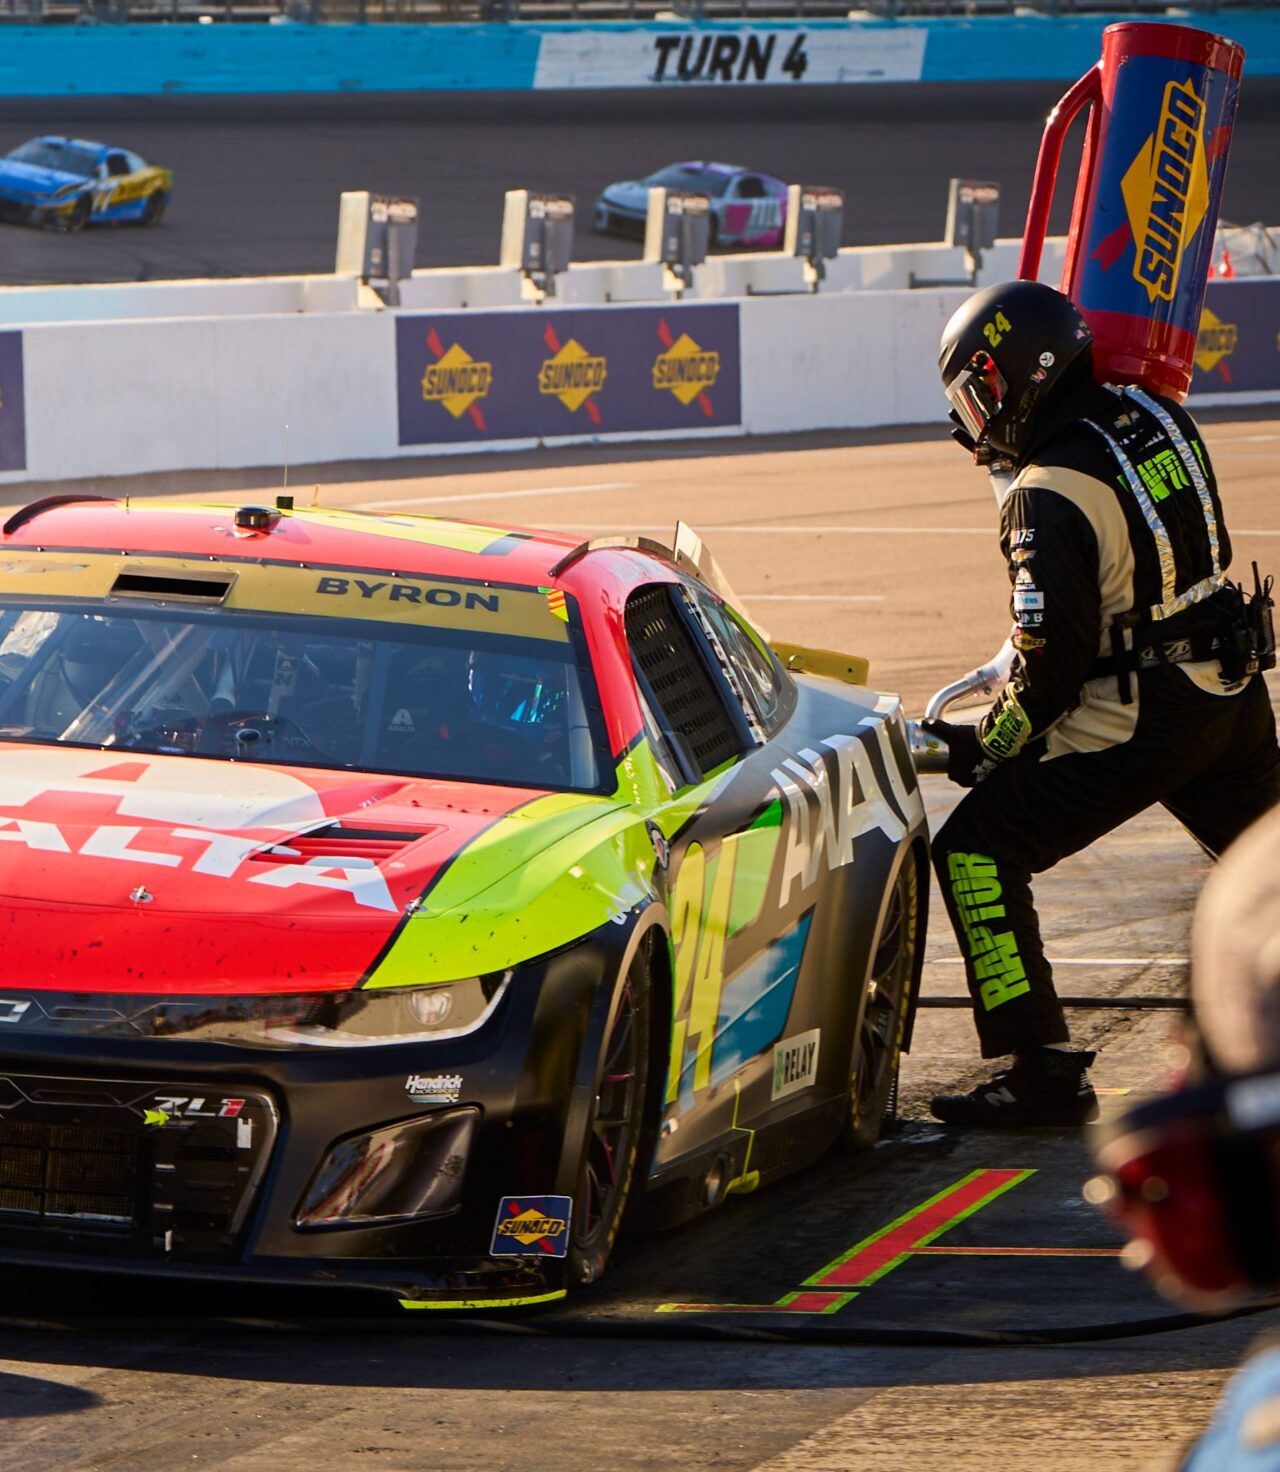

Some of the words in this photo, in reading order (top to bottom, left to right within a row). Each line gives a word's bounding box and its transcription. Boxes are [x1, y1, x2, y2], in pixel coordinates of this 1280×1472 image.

[653, 34, 776, 82] TURN
[781, 33, 808, 80] 4
[1140, 86, 1202, 297] SUNOCO
[983, 311, 1012, 348] 24
[426, 366, 489, 396] SUNOCO
[542, 361, 604, 391] SUNOCO
[655, 355, 717, 385] SUNOCO
[316, 577, 499, 613] BYRON
[947, 852, 1030, 1011] RAPTOR
[665, 840, 739, 1104] 24
[784, 1041, 816, 1085] RELAY
[405, 1075, 463, 1094] Hendrick
[502, 1220, 562, 1234] SUNOCO
